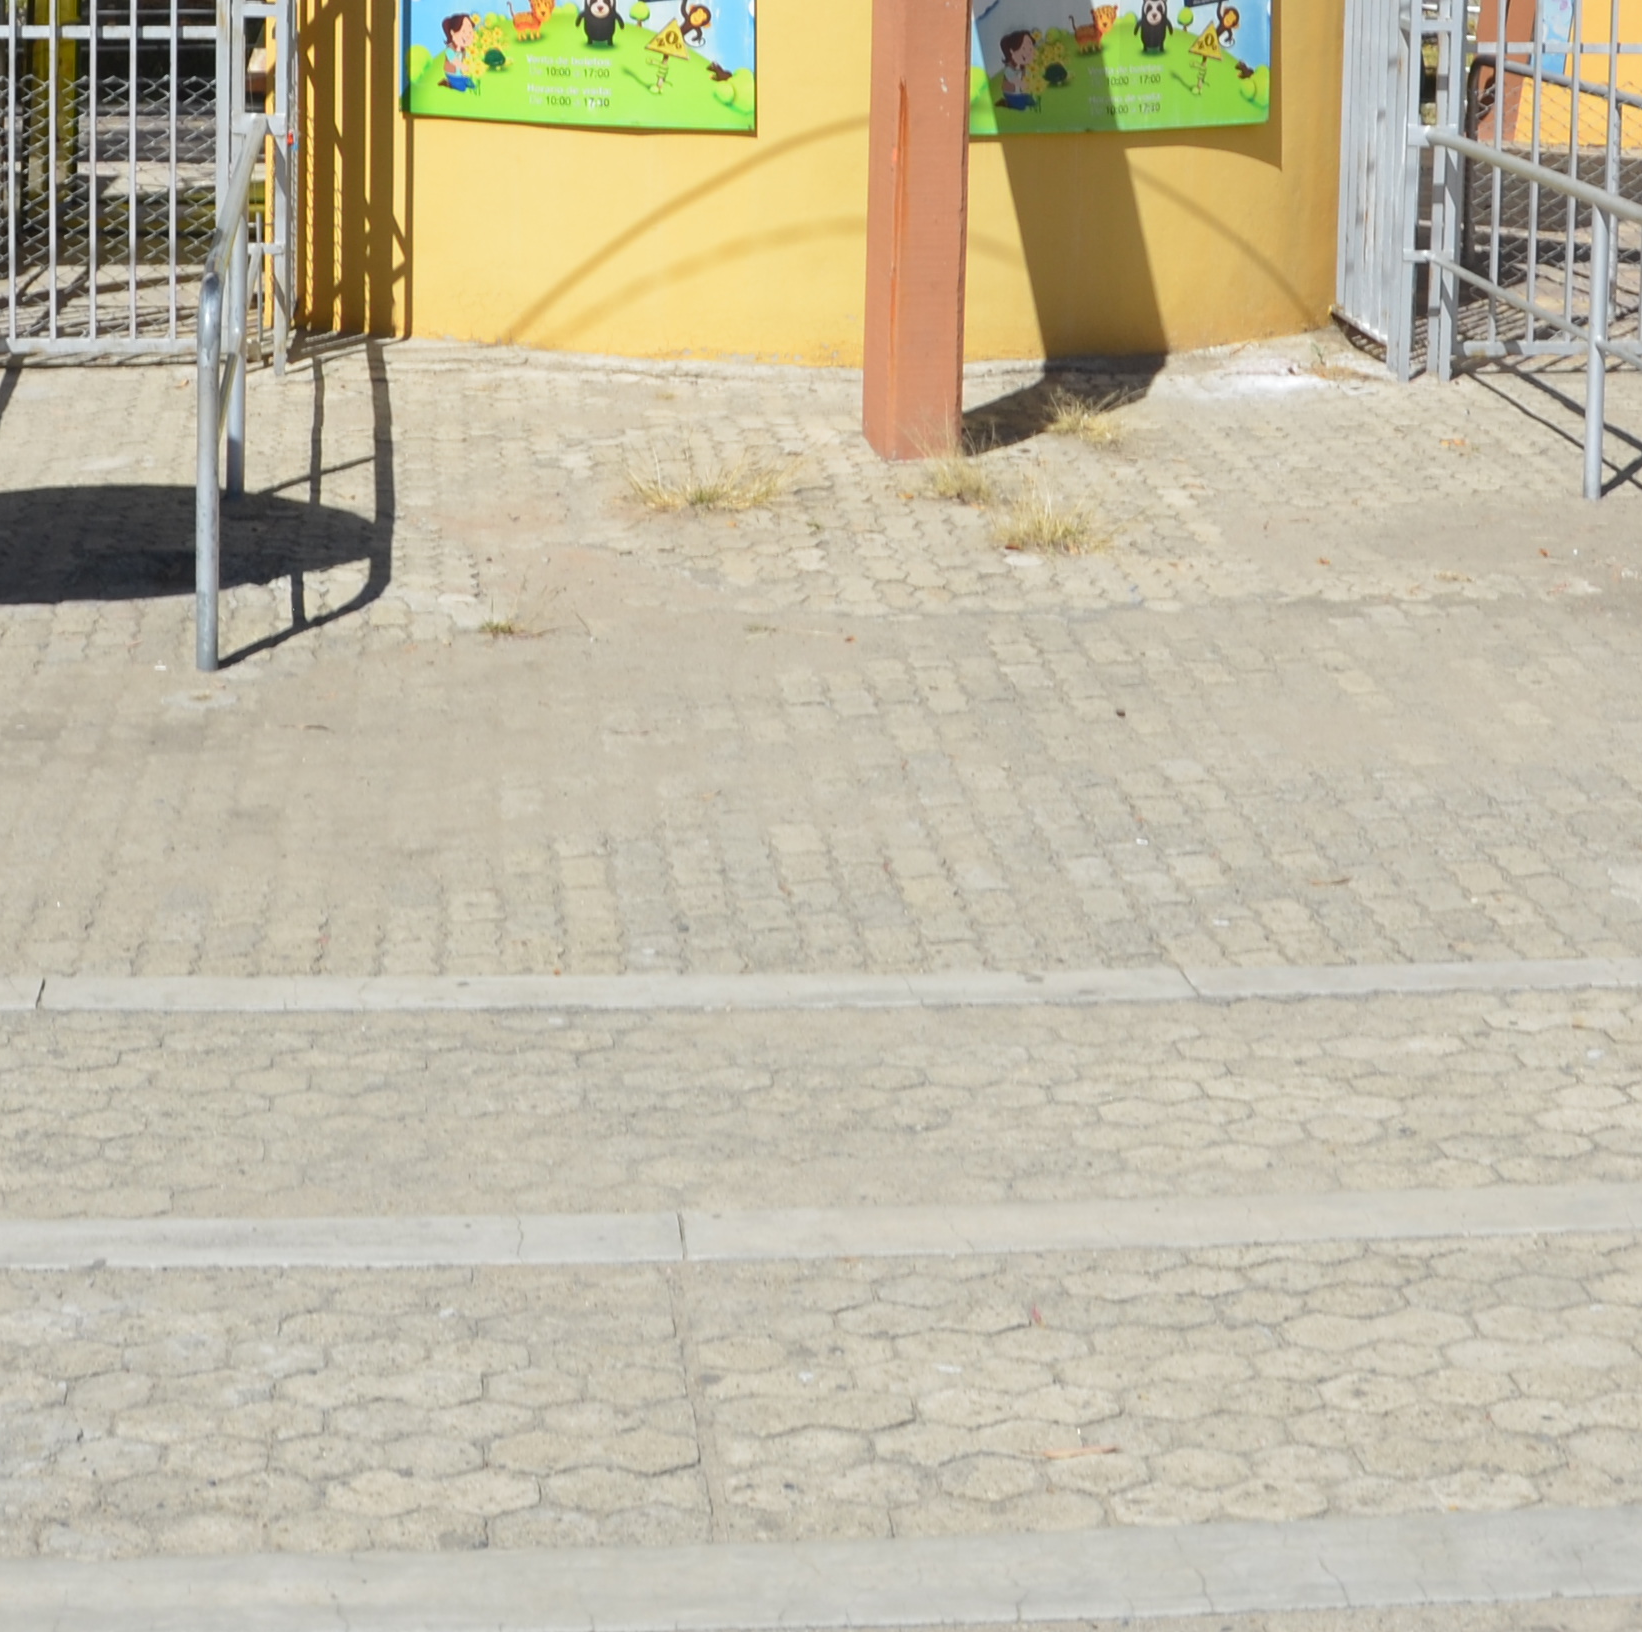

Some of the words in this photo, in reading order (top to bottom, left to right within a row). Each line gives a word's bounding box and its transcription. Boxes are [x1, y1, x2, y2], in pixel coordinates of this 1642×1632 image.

[545, 68, 570, 77] 10:00
[584, 69, 610, 78] 17:00
[546, 96, 571, 106] 10:00
